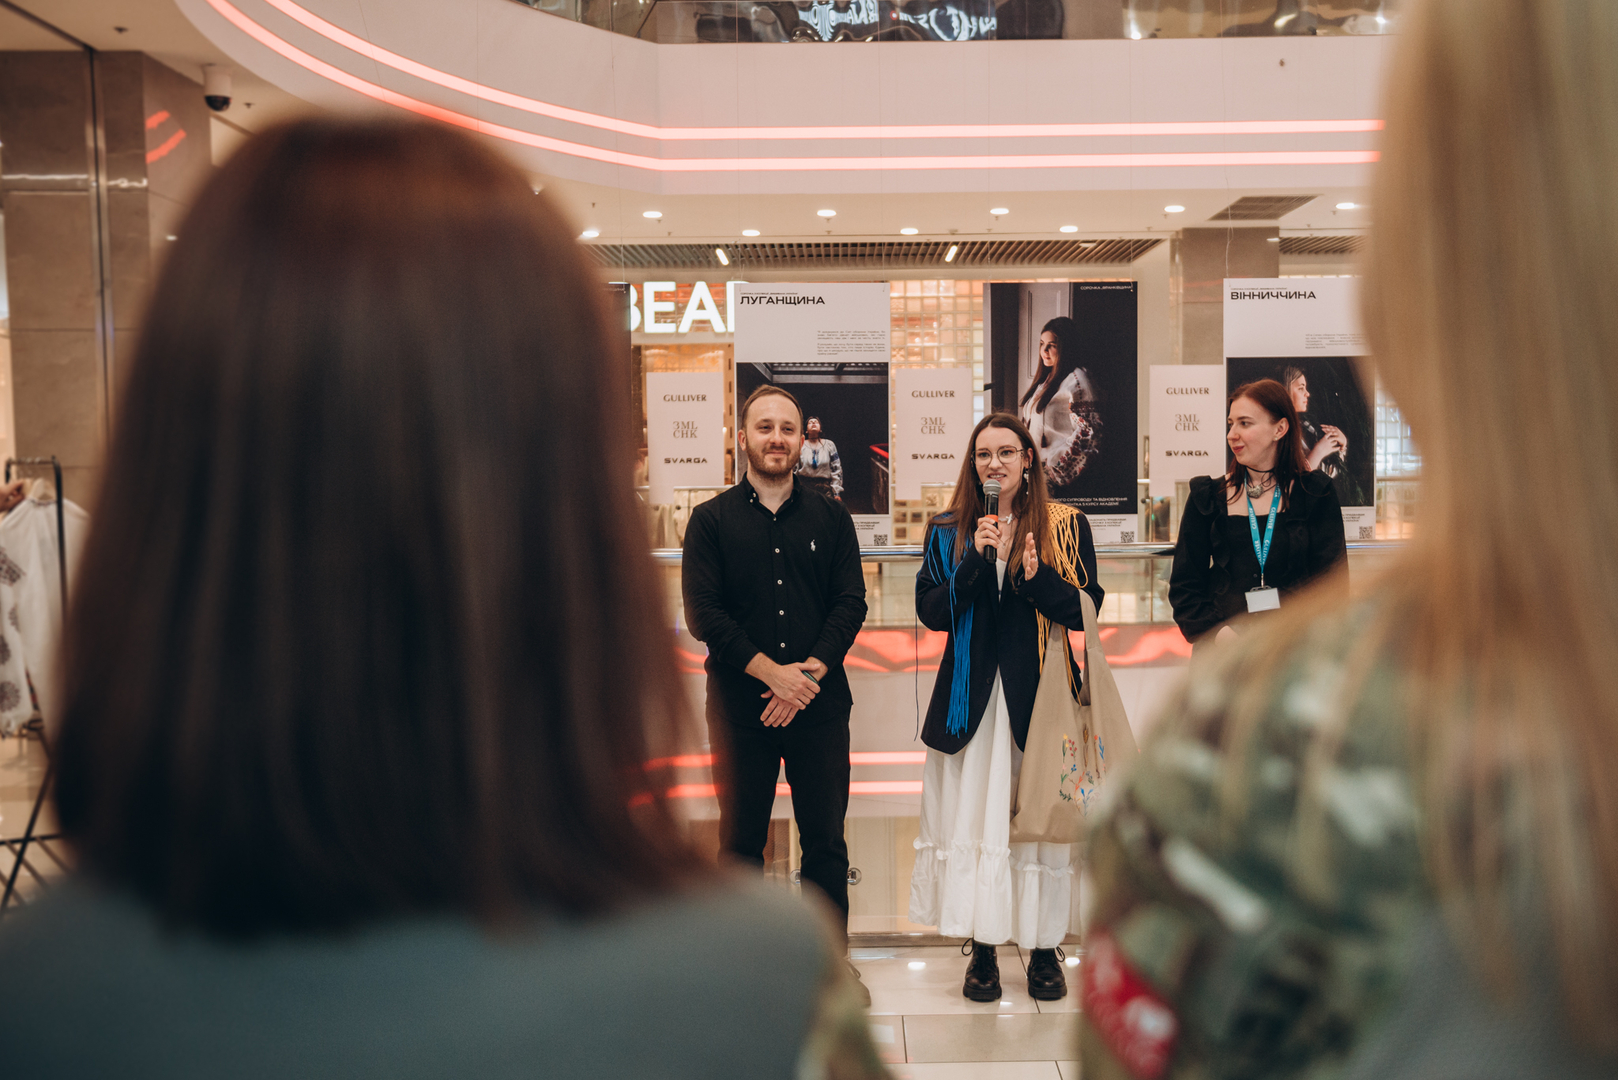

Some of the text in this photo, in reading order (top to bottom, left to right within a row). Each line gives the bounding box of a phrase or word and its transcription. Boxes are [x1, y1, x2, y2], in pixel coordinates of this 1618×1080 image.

[1230, 290, 1317, 301] ВІННИЧЧИНА
[740, 296, 826, 306] ЛУГАНЩИНА
[911, 390, 956, 399] GULLIVER
[1166, 387, 1210, 396] GULLIVER
[663, 394, 708, 403] GULLIVER
